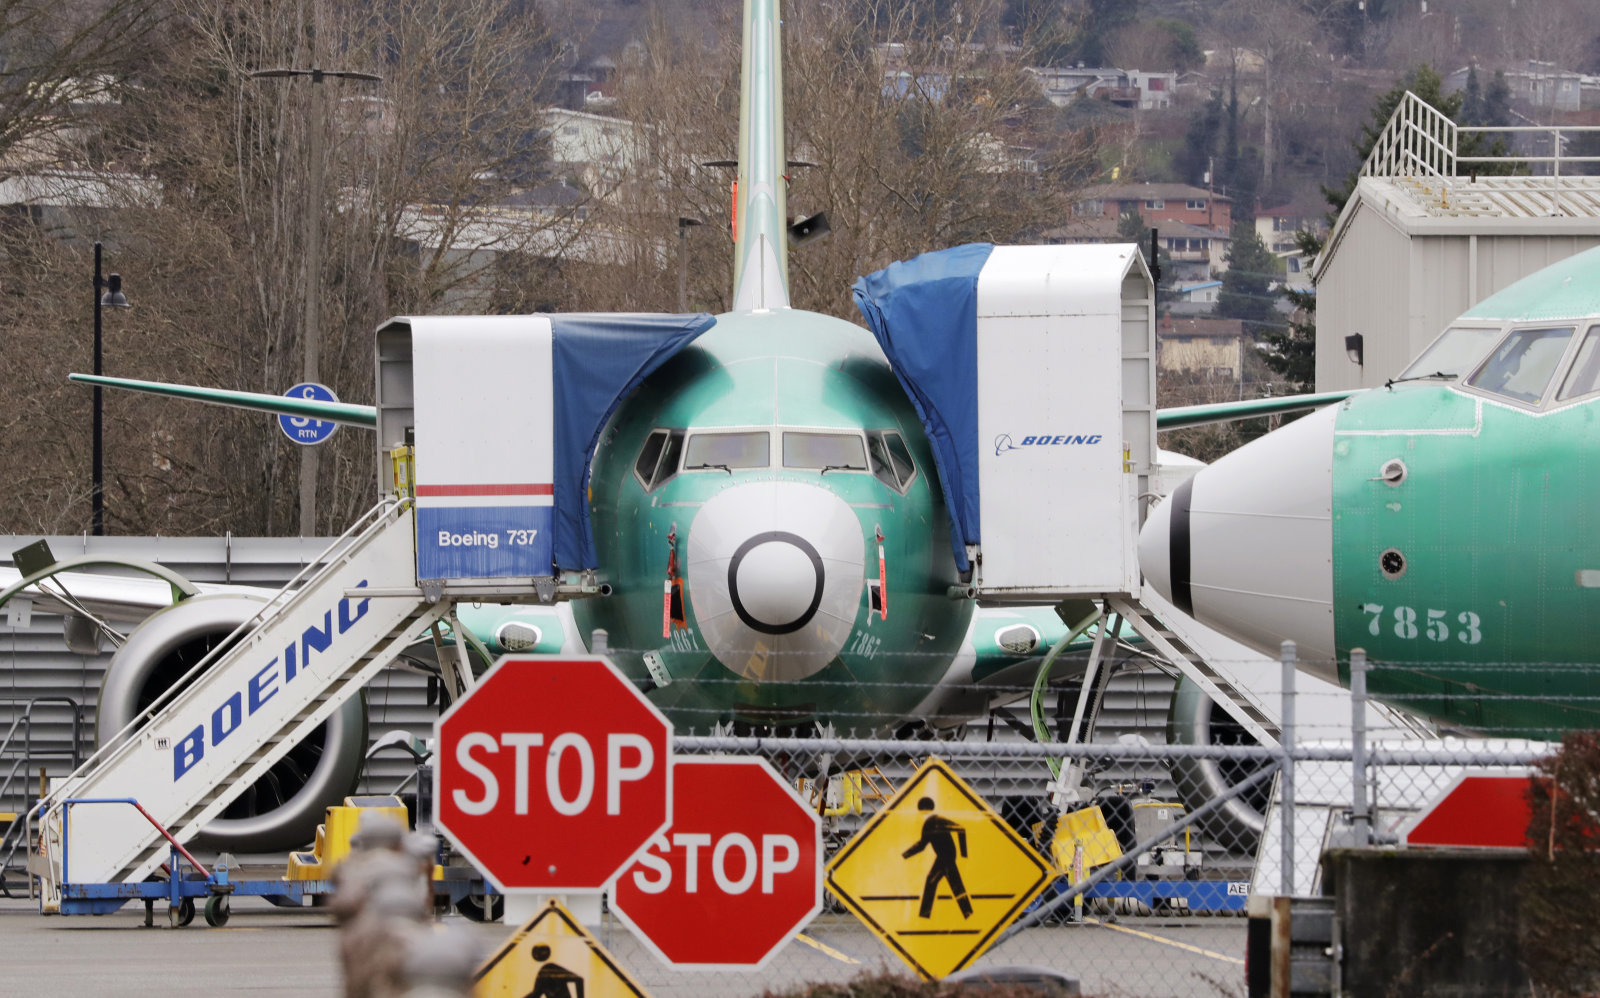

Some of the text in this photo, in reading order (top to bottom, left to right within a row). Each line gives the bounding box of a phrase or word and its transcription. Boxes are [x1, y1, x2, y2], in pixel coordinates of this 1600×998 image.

[303, 386, 315, 400] C
[298, 429, 318, 438] RTN
[1020, 434, 1103, 446] BOEING
[438, 529, 538, 549] Boeing 737
[1363, 603, 1482, 645] 7853
[850, 630, 881, 661] 7867
[173, 579, 372, 783] BOEING
[452, 731, 655, 816] STOP
[632, 832, 800, 895] STOP
